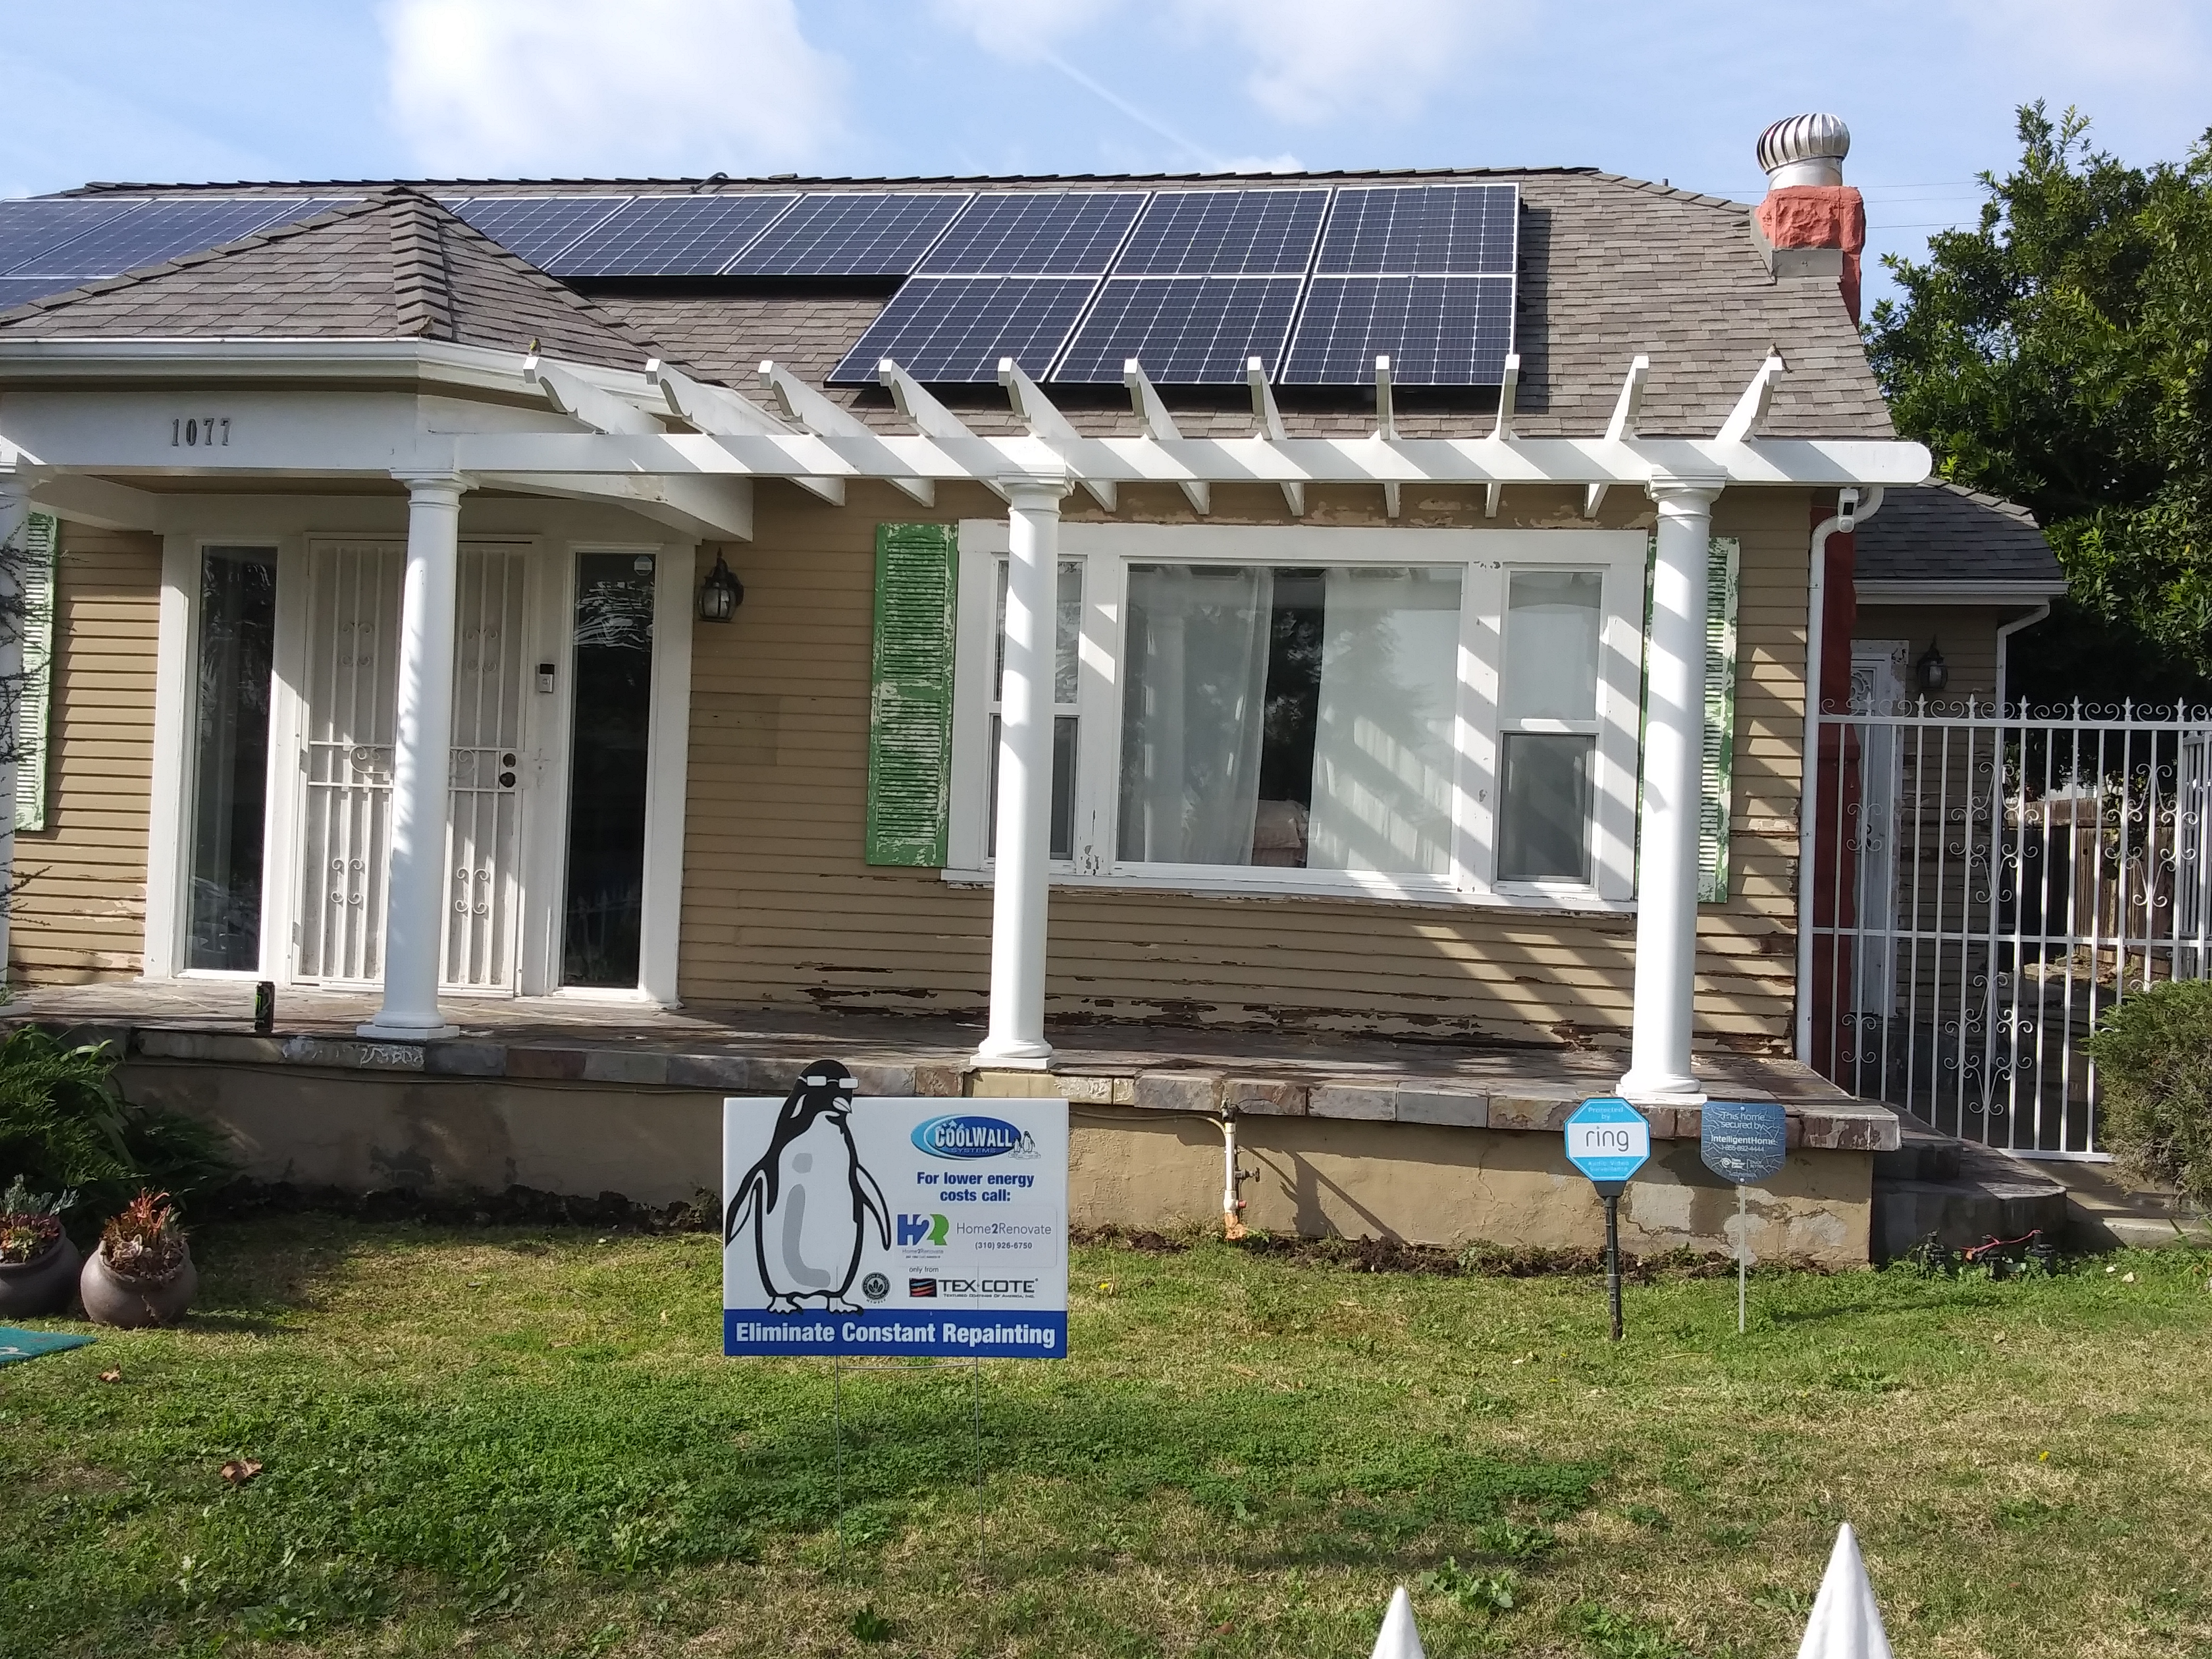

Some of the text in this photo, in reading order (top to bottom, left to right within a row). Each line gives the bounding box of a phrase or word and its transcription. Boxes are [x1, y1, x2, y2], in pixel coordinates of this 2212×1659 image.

[172, 418, 231, 446] 1077
[1722, 1111, 1739, 1120] This
[1754, 1121, 1763, 1131] by
[935, 1126, 1013, 1147] COOLWALL
[1586, 1126, 1629, 1152] ring
[1711, 1135, 1776, 1145] IntelligentHome
[917, 1172, 1035, 1188] For lower energy
[940, 1189, 1011, 1202] costs call:
[957, 1222, 1052, 1235] Home2Renovate
[975, 1242, 995, 1250] (310)
[736, 1322, 1056, 1348] Eliminate Constant Repainting
